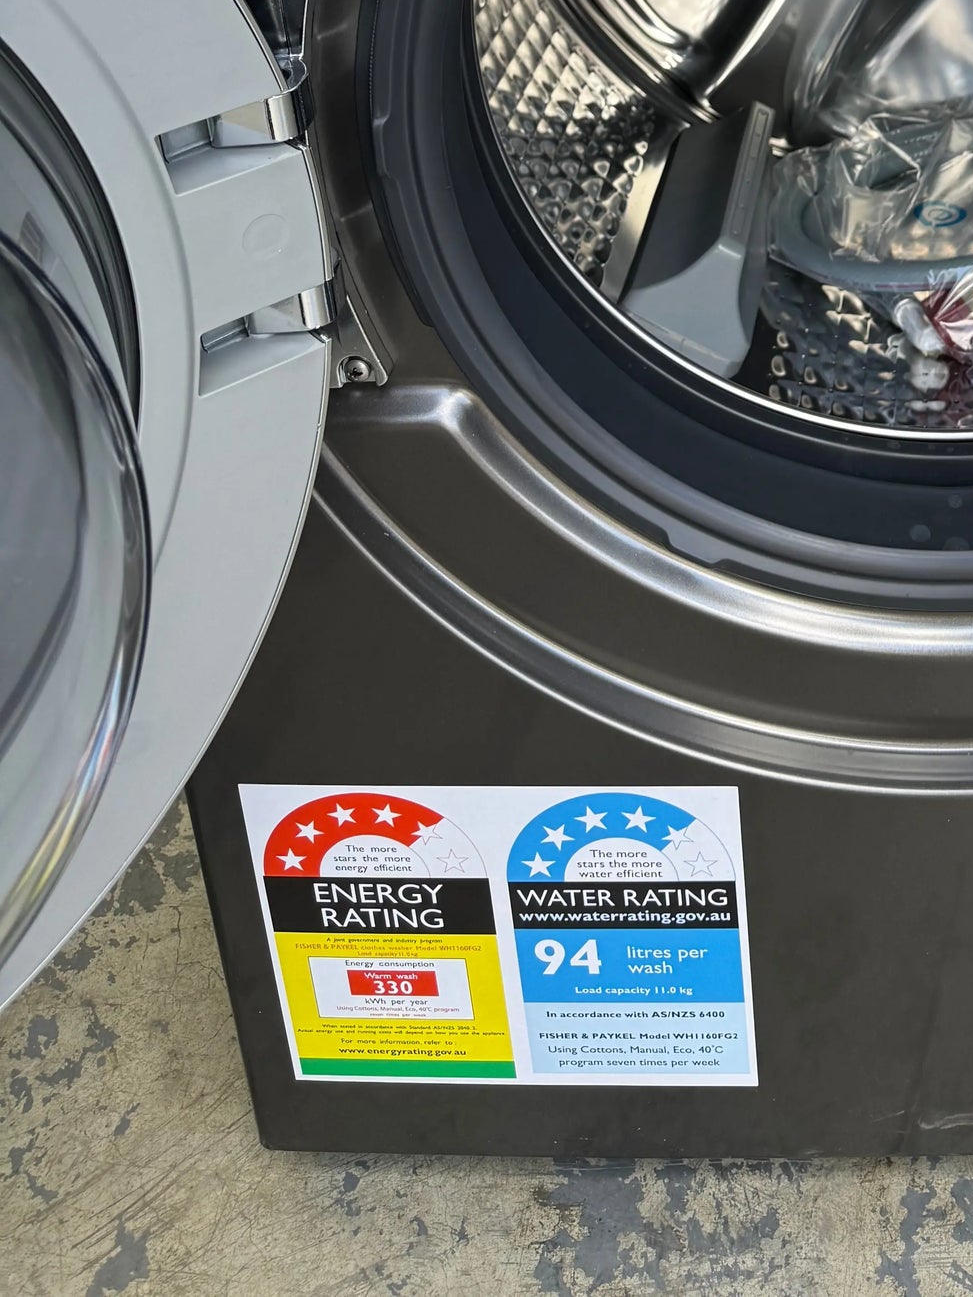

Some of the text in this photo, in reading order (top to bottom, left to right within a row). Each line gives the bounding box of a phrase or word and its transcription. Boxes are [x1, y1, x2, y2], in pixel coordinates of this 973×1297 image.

[346, 845, 365, 853] The
[590, 850, 612, 858] The
[335, 864, 412, 873] energy efficient
[609, 860, 628, 868] the
[579, 869, 663, 878] water efficient
[313, 882, 443, 904] ENERGY
[517, 889, 728, 907] WATER RATING
[321, 908, 444, 928] RATING
[519, 910, 731, 924] www.waterrating.gov.au
[534, 939, 602, 975] 94
[627, 945, 708, 962] litres per
[345, 960, 434, 968] Energy consumption
[628, 961, 673, 974] wash
[374, 981, 413, 994] 330
[575, 986, 693, 996] Load capacity 11.0 kg
[625, 1010, 648, 1018] with
[651, 1011, 696, 1019] AS/NZS
[581, 1032, 589, 1040] &
[592, 1032, 636, 1040] PAYKEL
[673, 1032, 739, 1040] WH1160FG2
[338, 1047, 467, 1056] www.energyrating.gov.au
[548, 1046, 577, 1056] Using
[581, 1046, 627, 1055] Cottons,
[630, 1046, 669, 1054] Manual,
[559, 1059, 603, 1068] program
[639, 1058, 667, 1066] times
[671, 1059, 688, 1068] per
[692, 1058, 720, 1066] week
